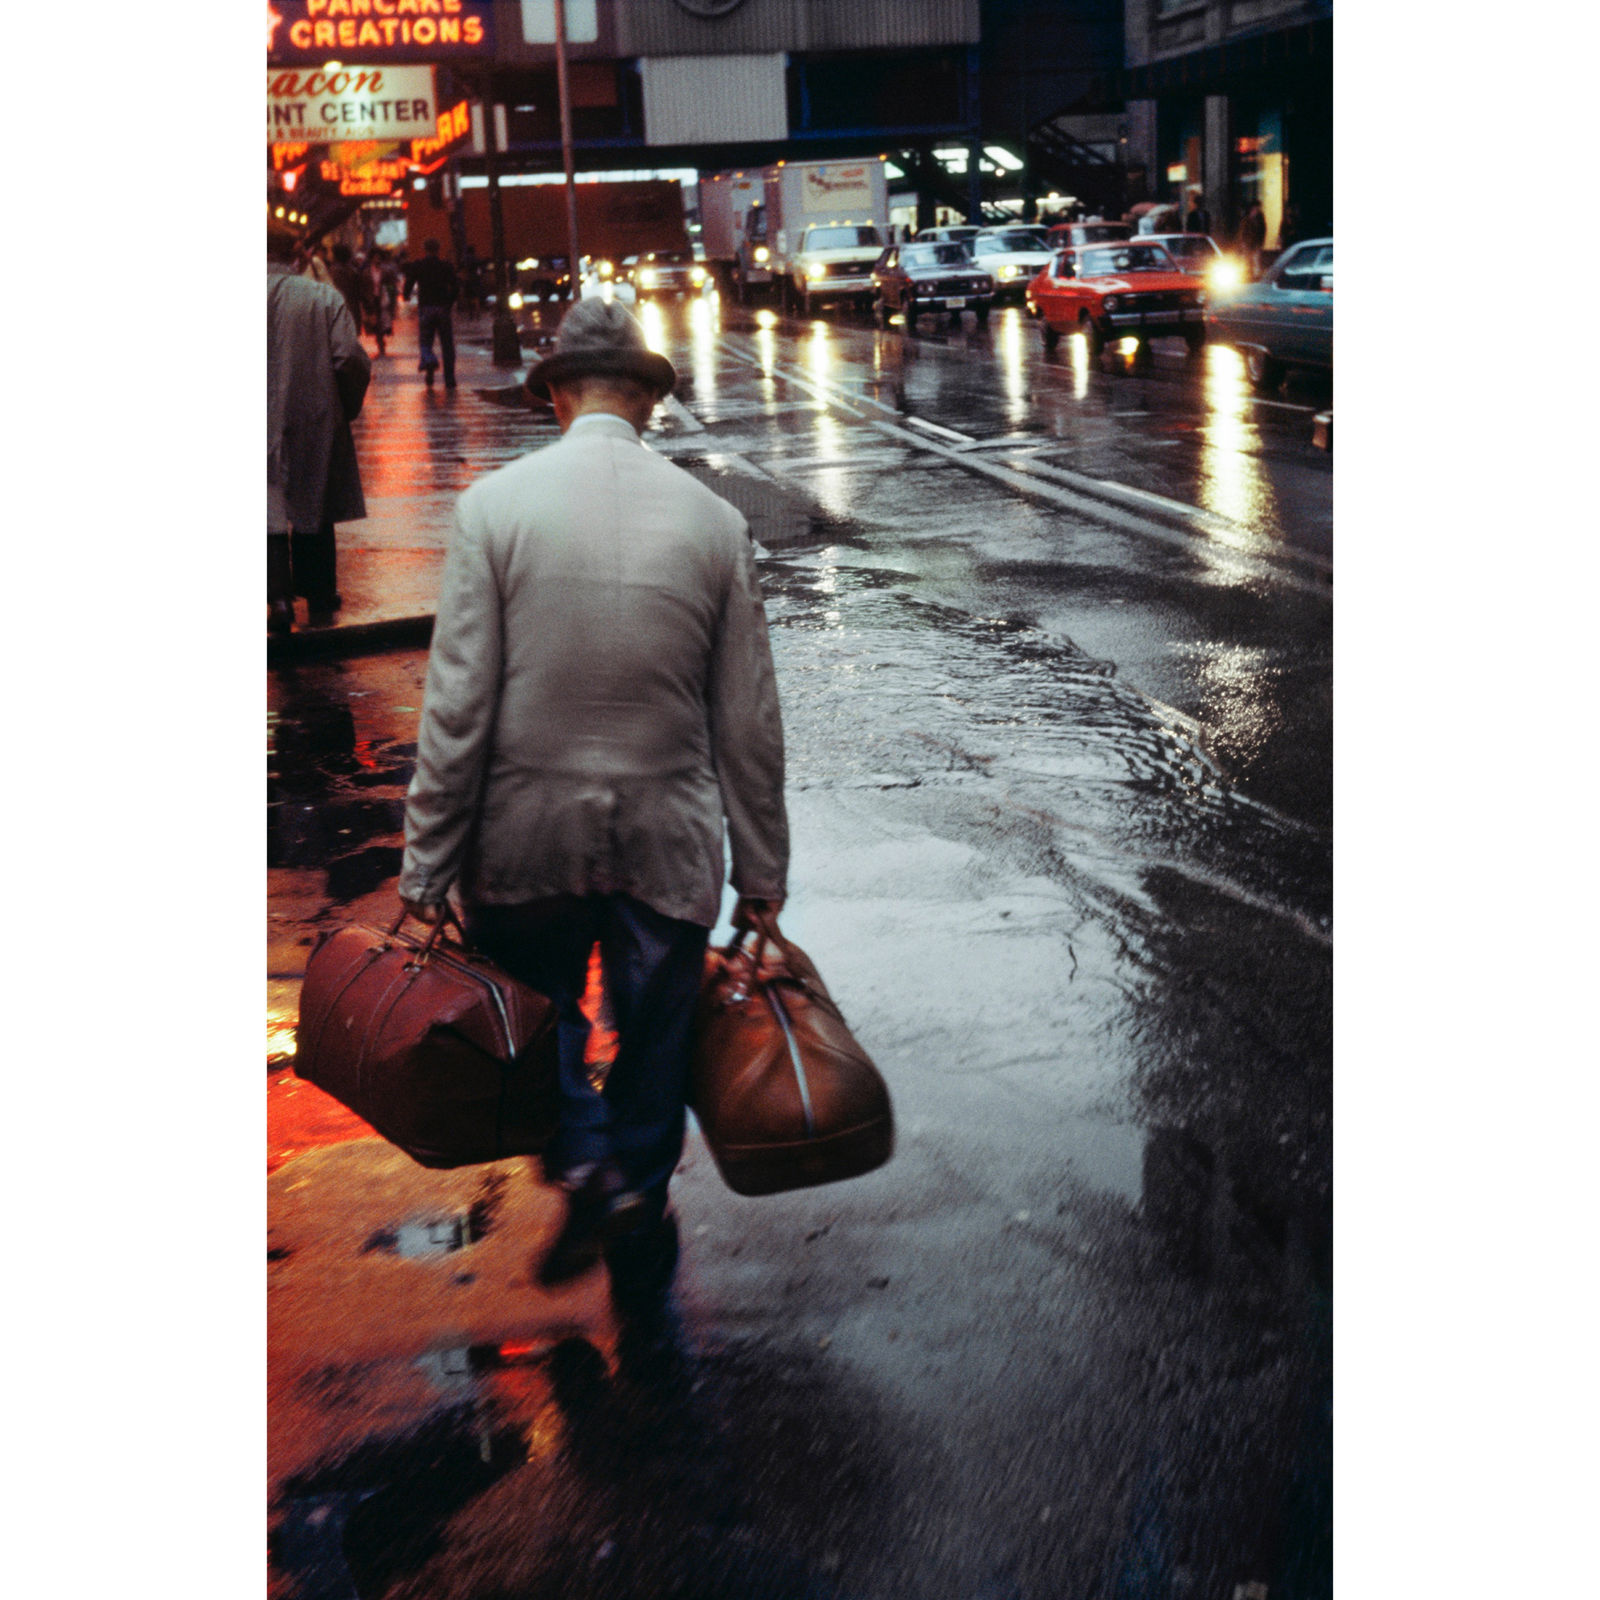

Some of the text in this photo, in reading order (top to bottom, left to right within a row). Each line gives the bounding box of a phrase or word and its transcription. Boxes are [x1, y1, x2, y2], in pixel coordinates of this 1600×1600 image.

[290, 16, 484, 48] CREATIONS
[267, 70, 384, 98] acon
[267, 99, 429, 125] NT CENTER
